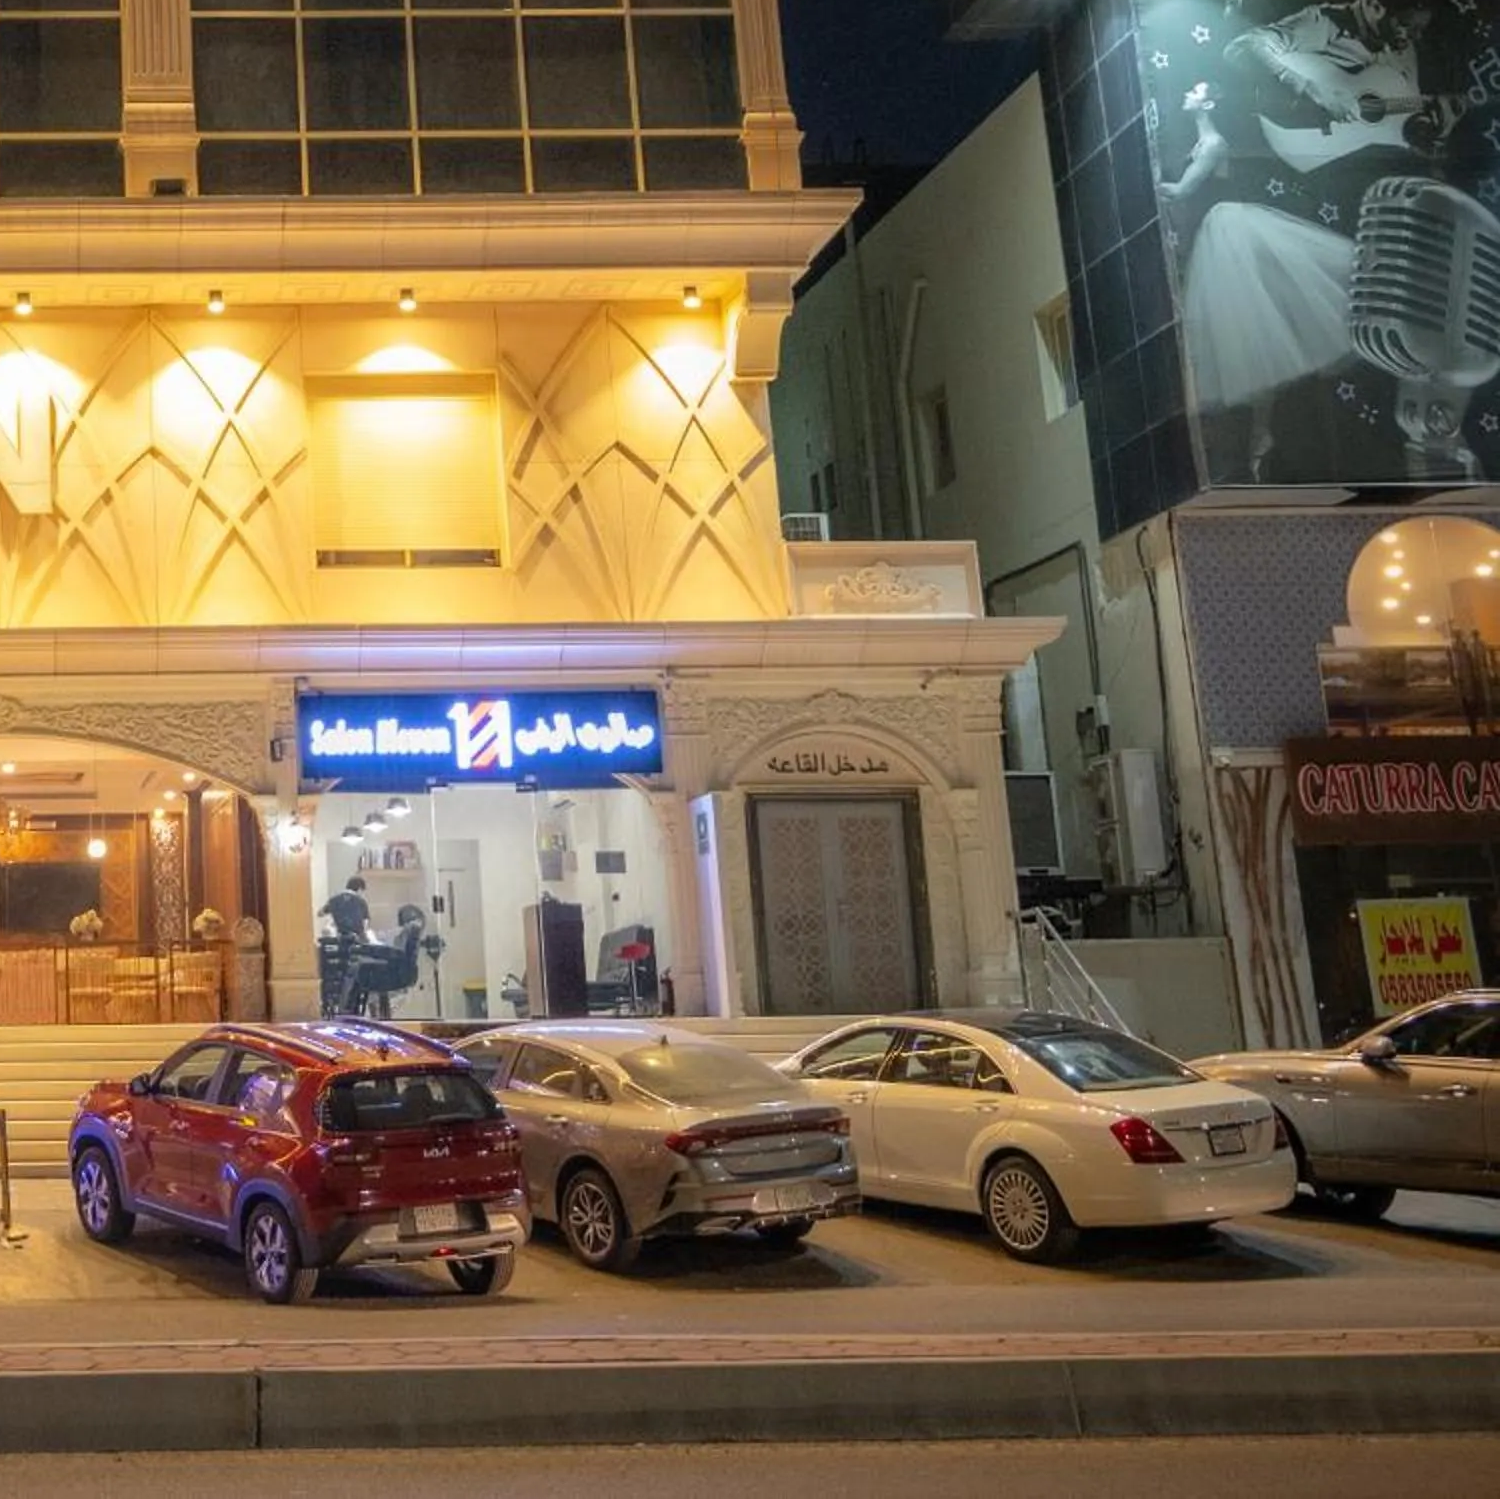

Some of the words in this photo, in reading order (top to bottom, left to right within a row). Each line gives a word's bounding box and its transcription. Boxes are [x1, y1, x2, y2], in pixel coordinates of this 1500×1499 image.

[828, 753, 889, 776] مدخل
[1298, 762, 1455, 815] CATURRA
[1452, 761, 1500, 814] CA
